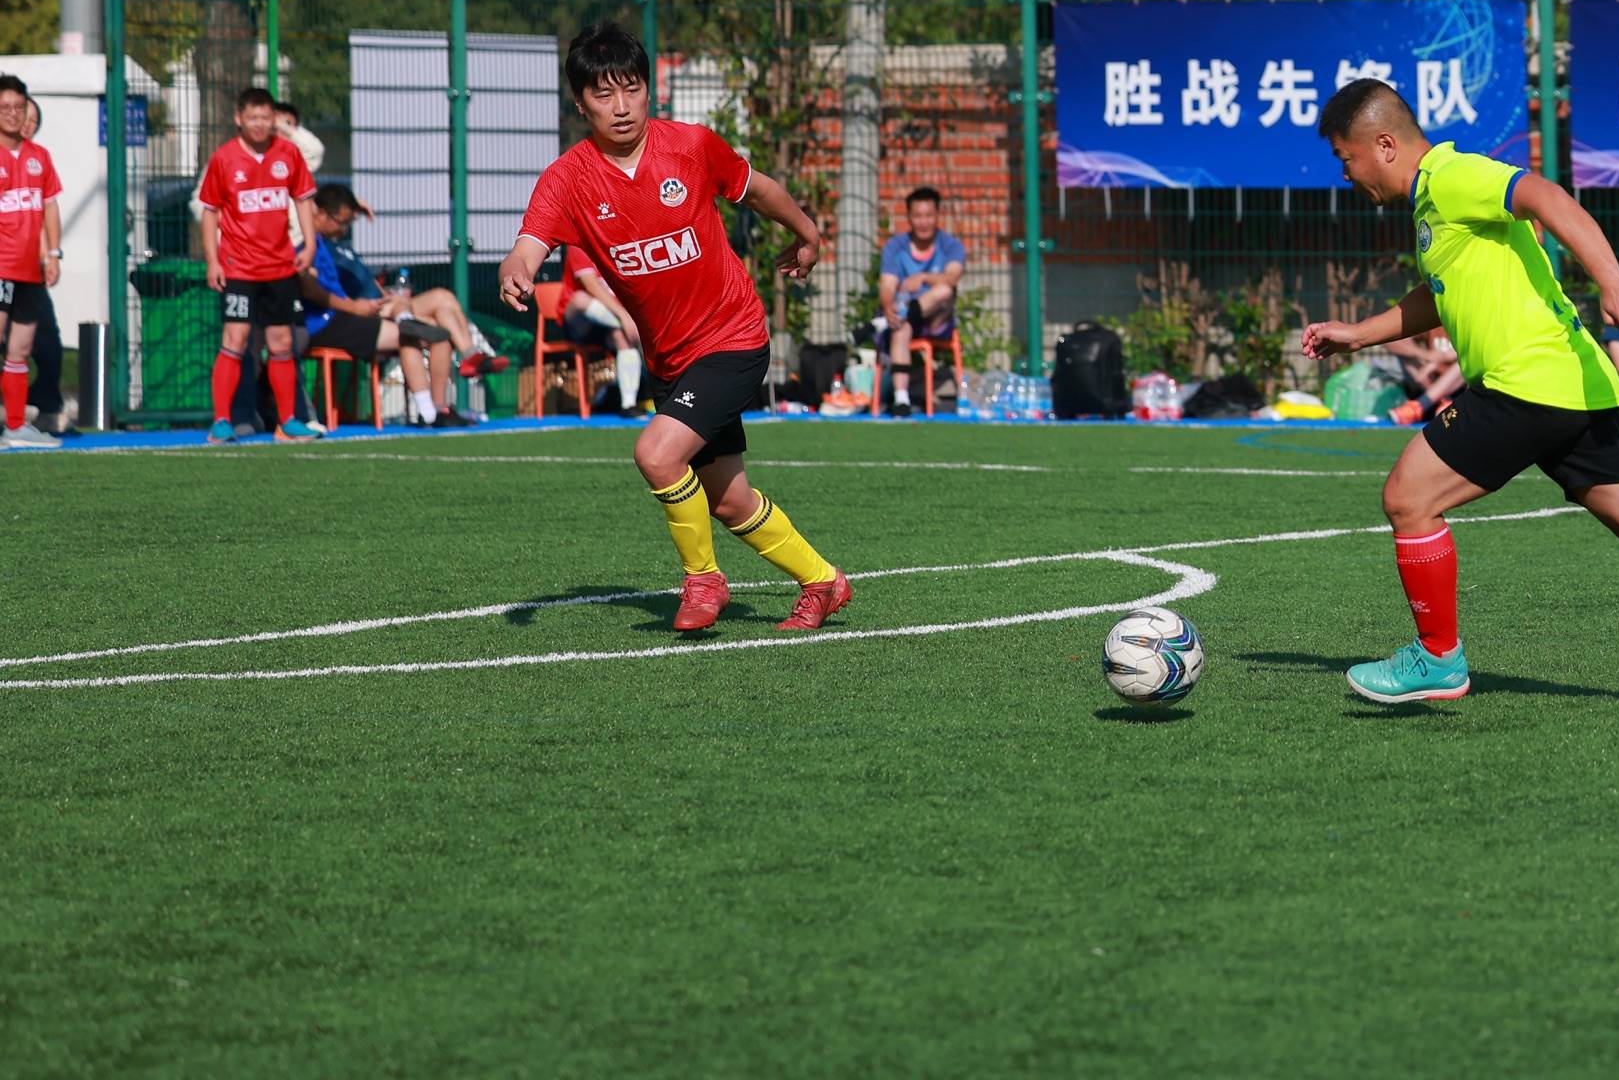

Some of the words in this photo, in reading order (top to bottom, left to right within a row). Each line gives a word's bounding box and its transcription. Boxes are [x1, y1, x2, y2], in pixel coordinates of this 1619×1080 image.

[237, 188, 289, 213] SCM
[597, 212, 617, 220] KELME
[610, 226, 700, 275] SCM
